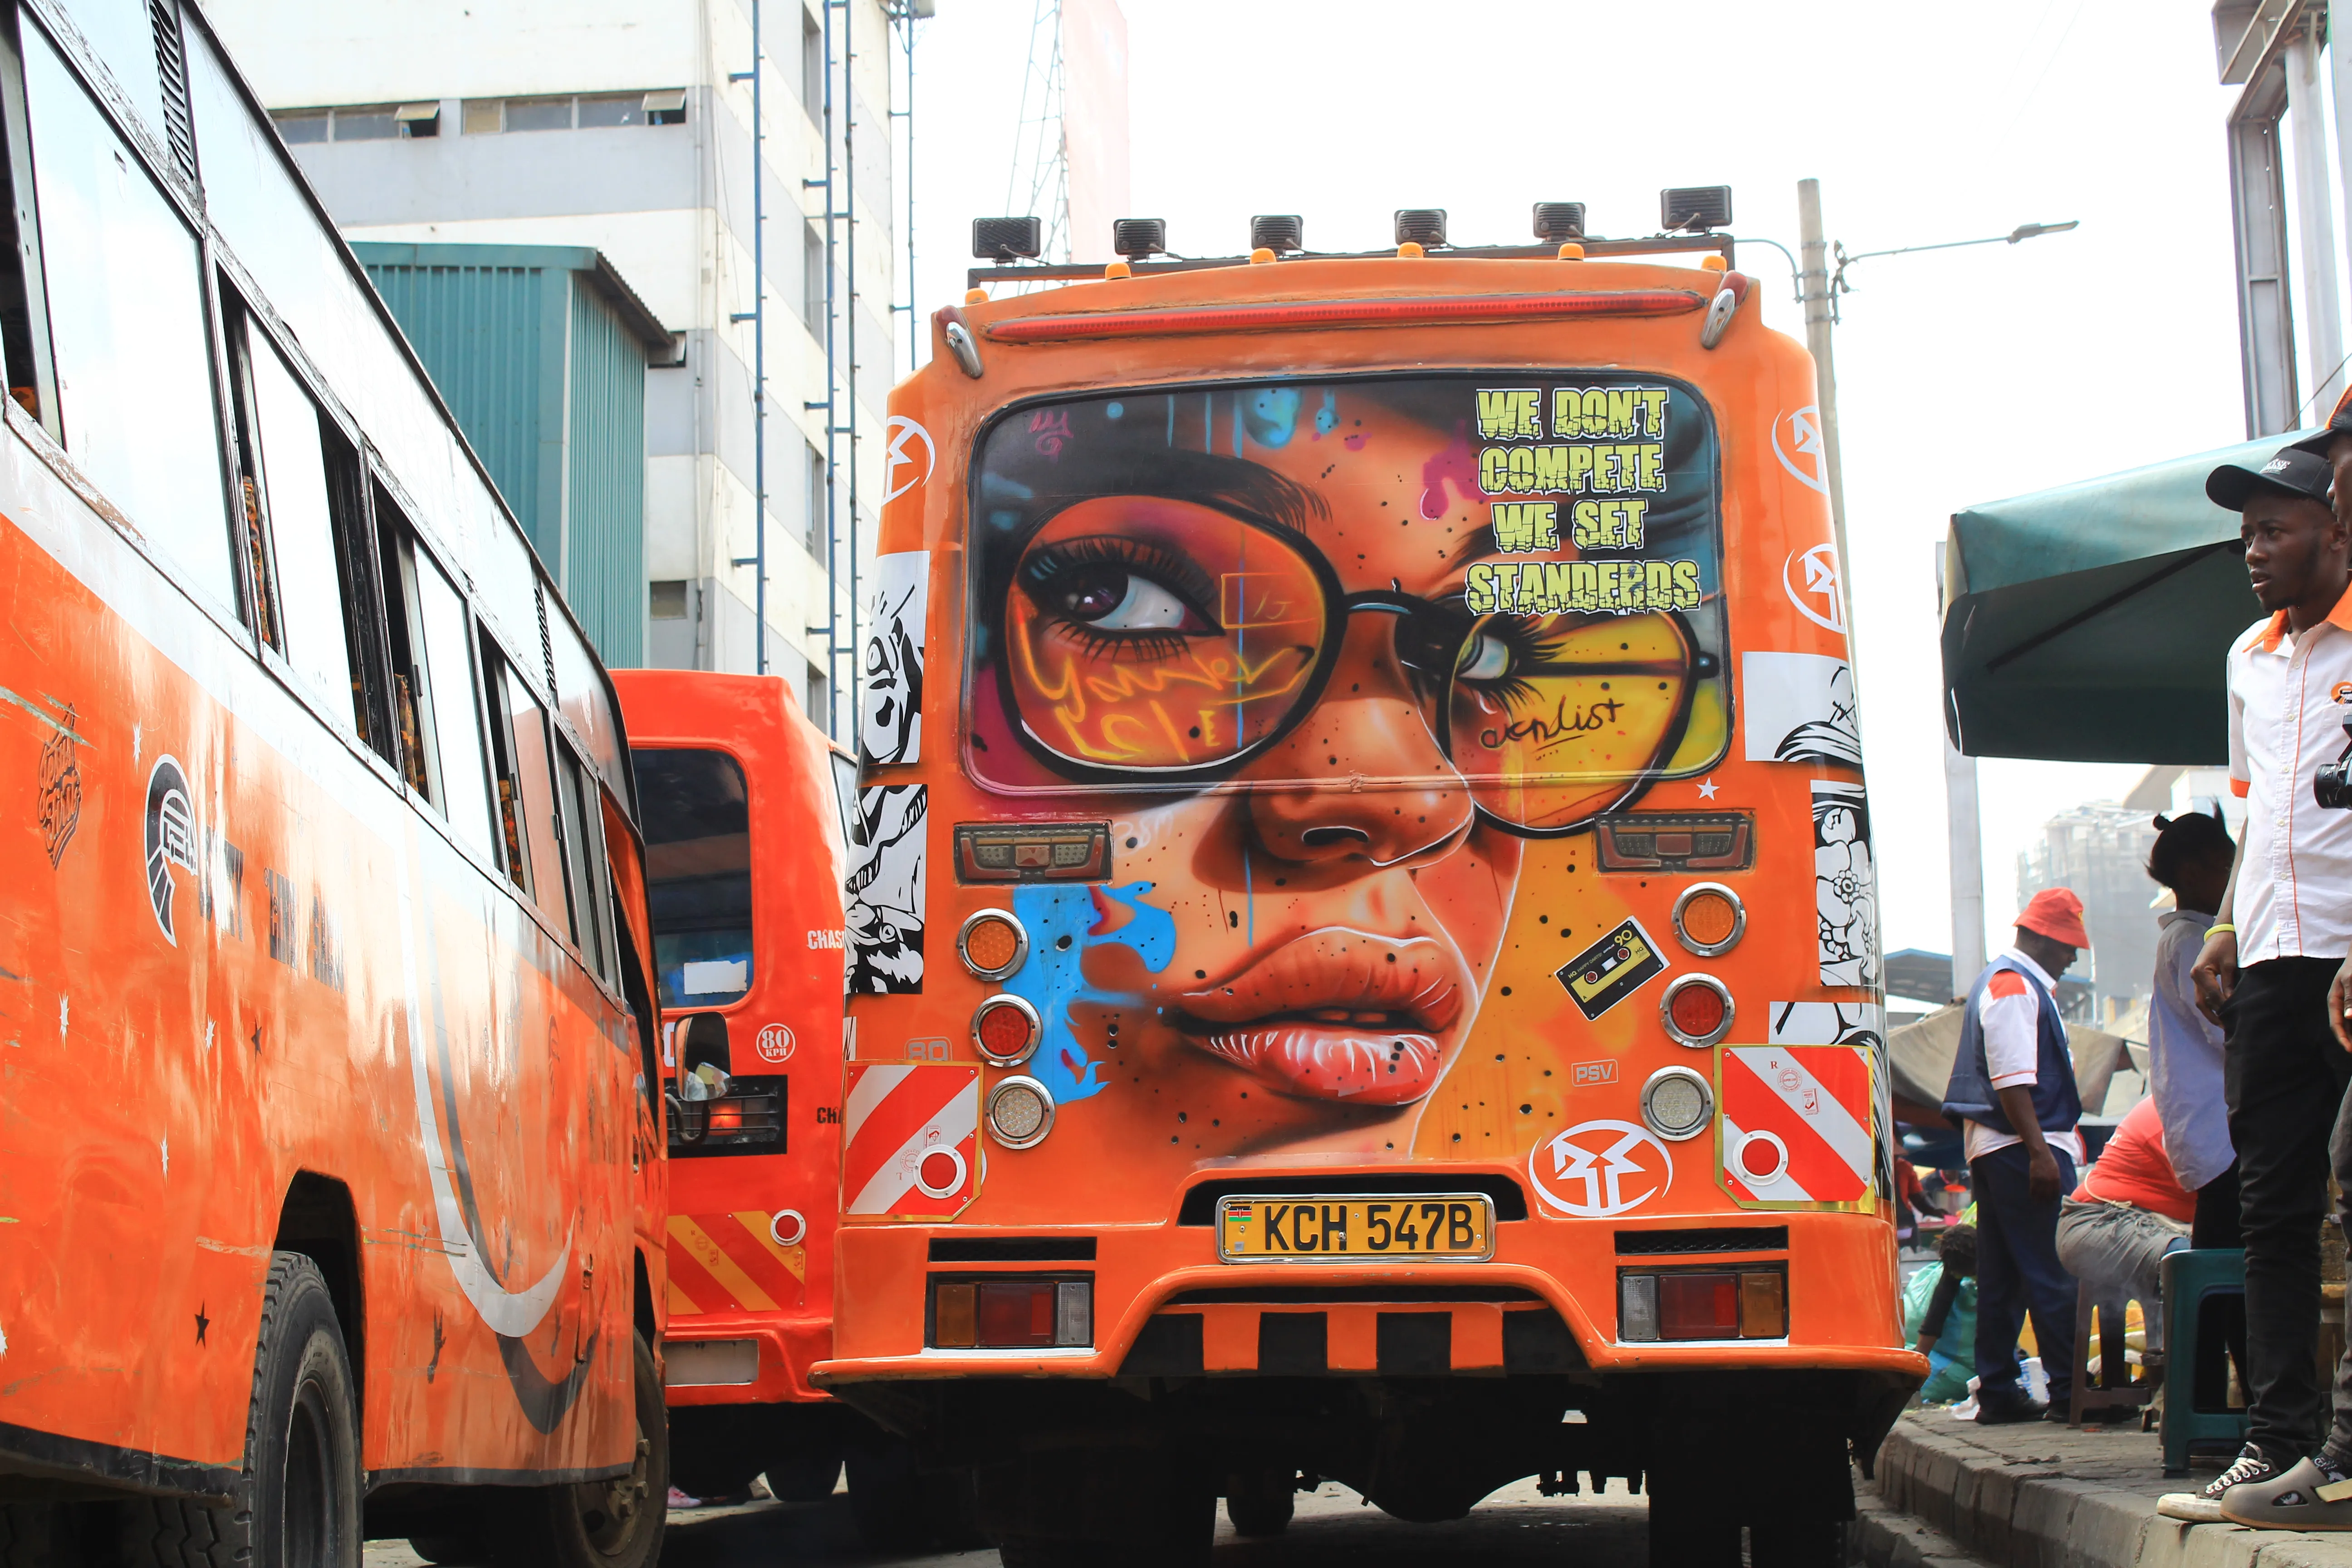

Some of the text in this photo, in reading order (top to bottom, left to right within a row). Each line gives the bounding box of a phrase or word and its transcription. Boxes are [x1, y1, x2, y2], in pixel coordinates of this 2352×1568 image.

[1477, 387, 1668, 439] WE DON'T
[1479, 443, 1666, 495] COMPETE
[1491, 499, 1648, 554] WE SET
[1465, 560, 1701, 616] STANDERDS
[1568, 971, 1578, 979] HQ
[1577, 961, 1590, 972] HAPPY
[1614, 930, 1632, 946] 90
[761, 1029, 790, 1049] 80
[765, 1048, 787, 1057] KPH
[1576, 1063, 1613, 1083] PSV
[1770, 1061, 1779, 1069] R
[1264, 1204, 1348, 1251] KCH
[1367, 1203, 1474, 1251] 547B
